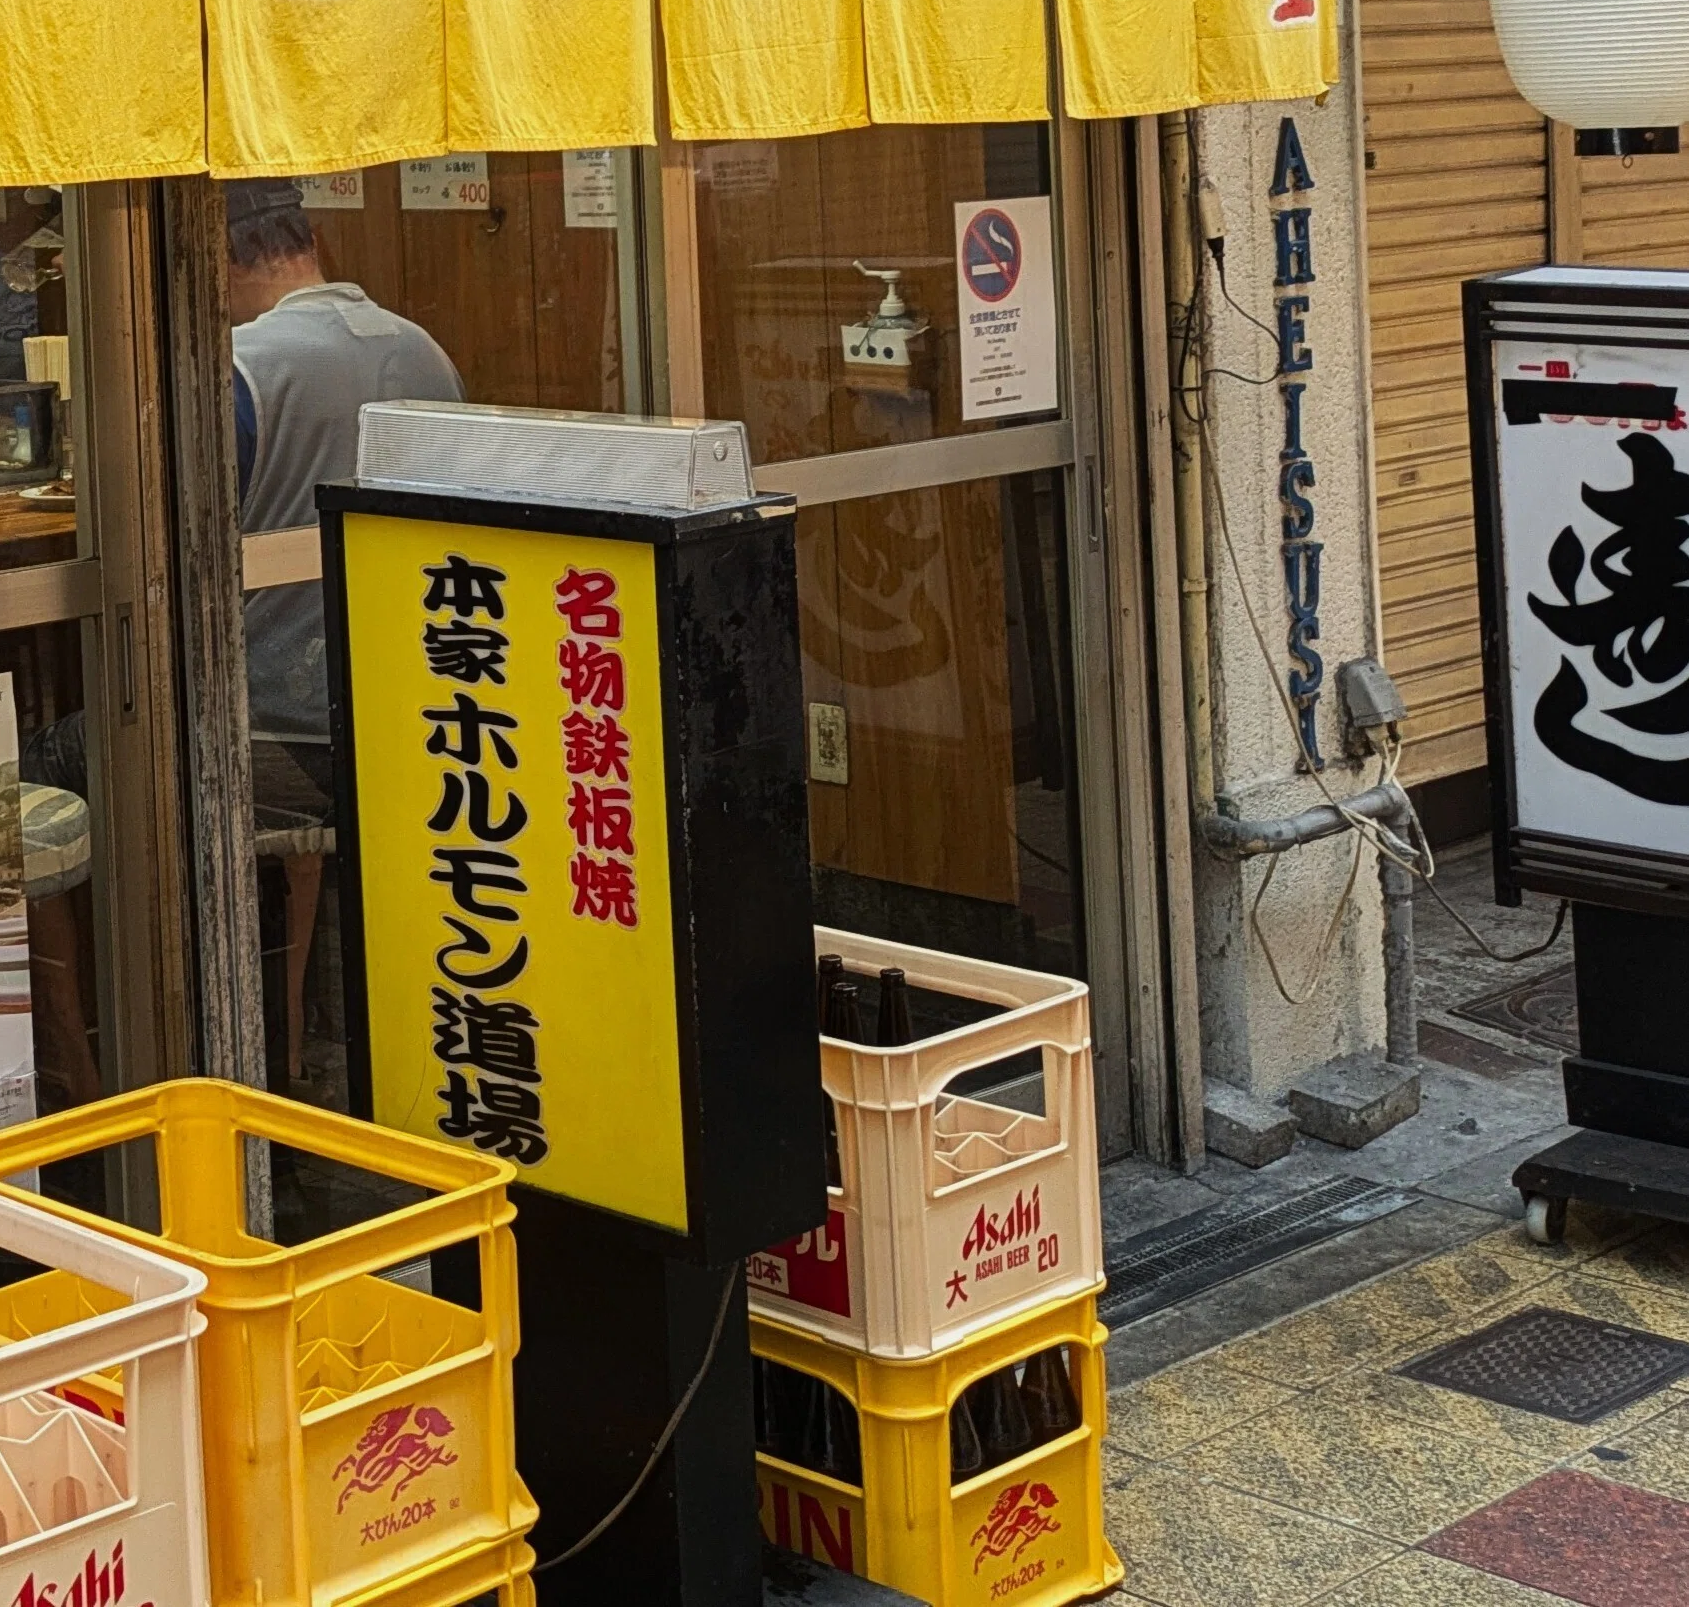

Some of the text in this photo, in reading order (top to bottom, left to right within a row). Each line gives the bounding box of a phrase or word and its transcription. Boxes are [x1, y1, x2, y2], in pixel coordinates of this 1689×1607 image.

[329, 177, 357, 195] 450
[459, 183, 487, 203] 400
[555, 568, 639, 928] 名物鉄板焼
[423, 554, 549, 1167] 本家ホルモン道場
[962, 1183, 1042, 1261] Asahi
[945, 1233, 1059, 1310] 大 ASAHI BEER 20
[360, 1497, 437, 1546] 大びん20本
[759, 1482, 854, 1575] IN
[991, 1559, 1046, 1601] 大びん20本
